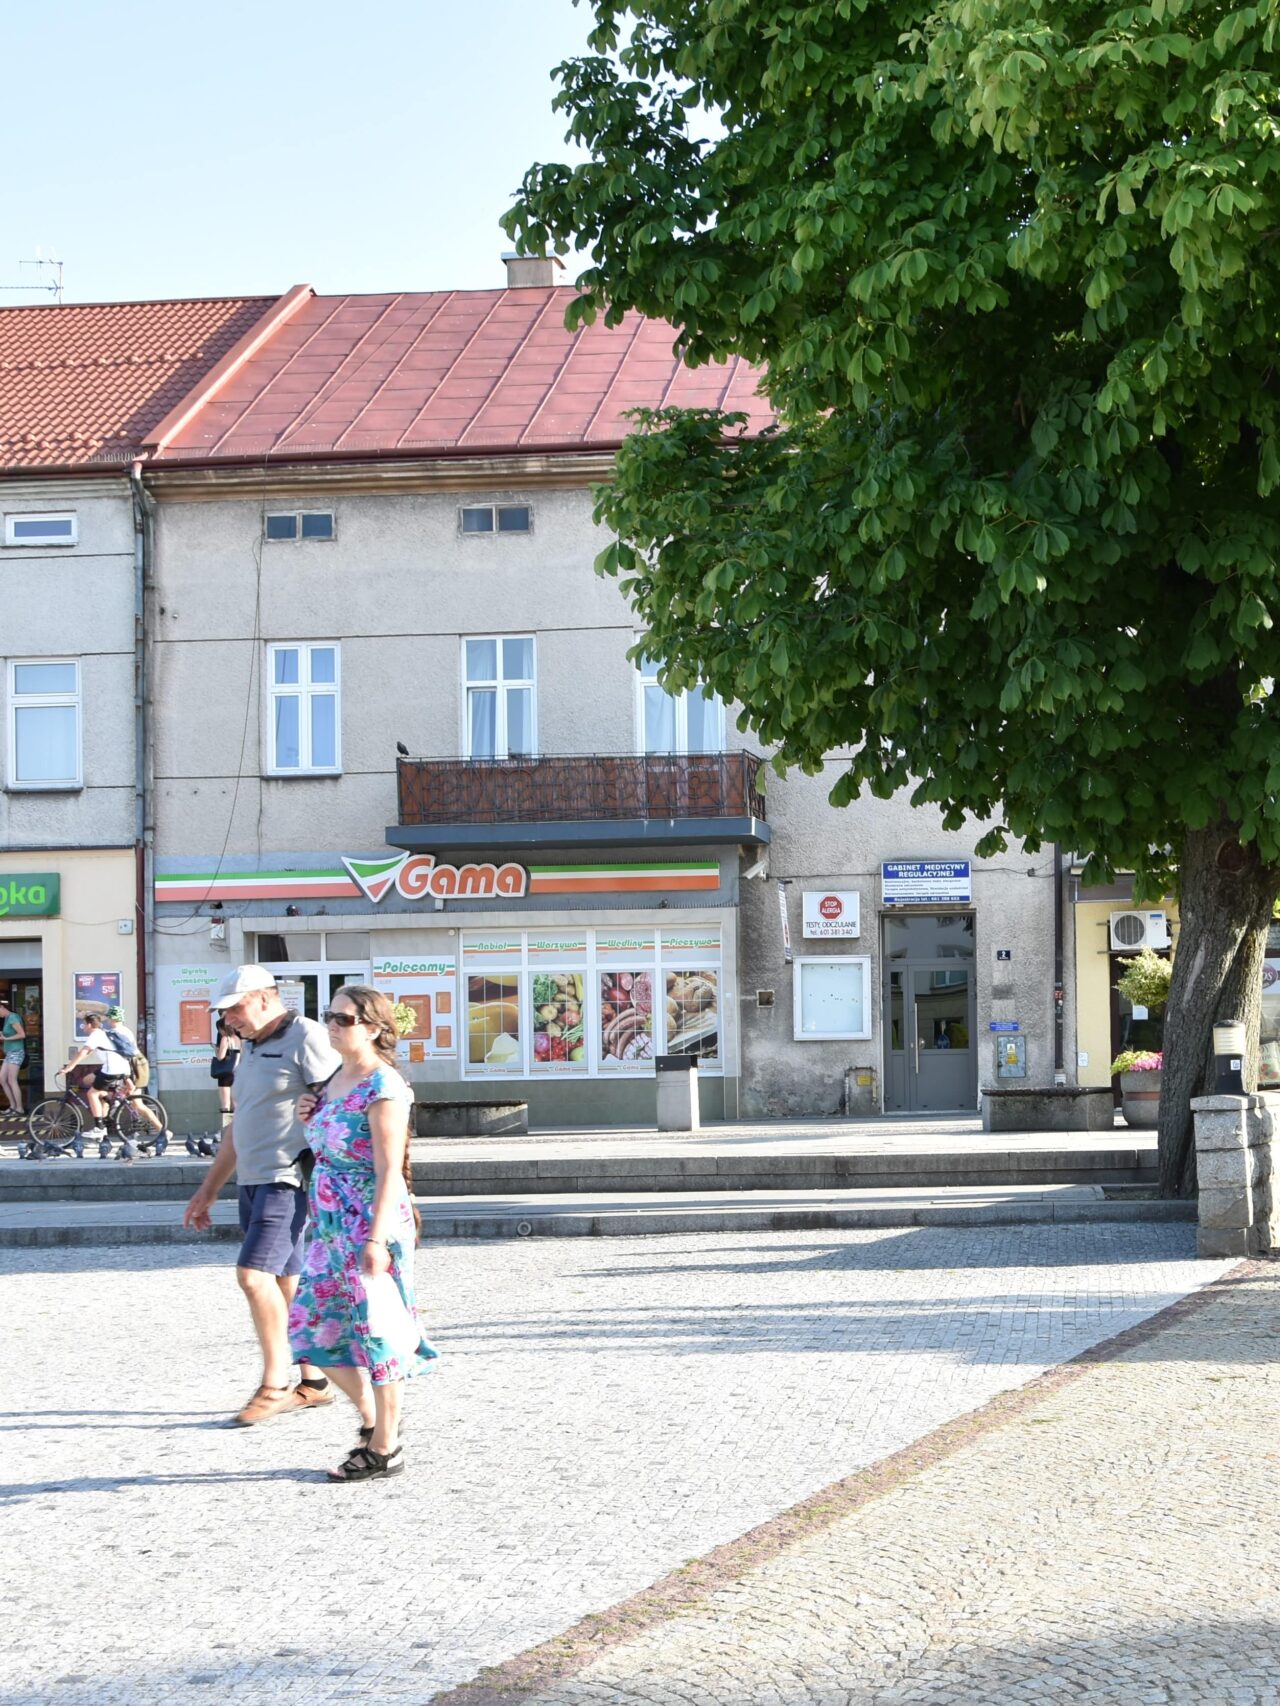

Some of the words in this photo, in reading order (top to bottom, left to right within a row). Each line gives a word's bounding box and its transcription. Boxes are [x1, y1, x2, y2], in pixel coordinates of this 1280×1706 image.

[887, 864, 921, 872] GABINET
[924, 863, 966, 871] MEDYCYNY
[397, 854, 526, 897] Gama
[898, 870, 955, 878] REGULACYJNEJ
[382, 961, 446, 974] Polecamy
